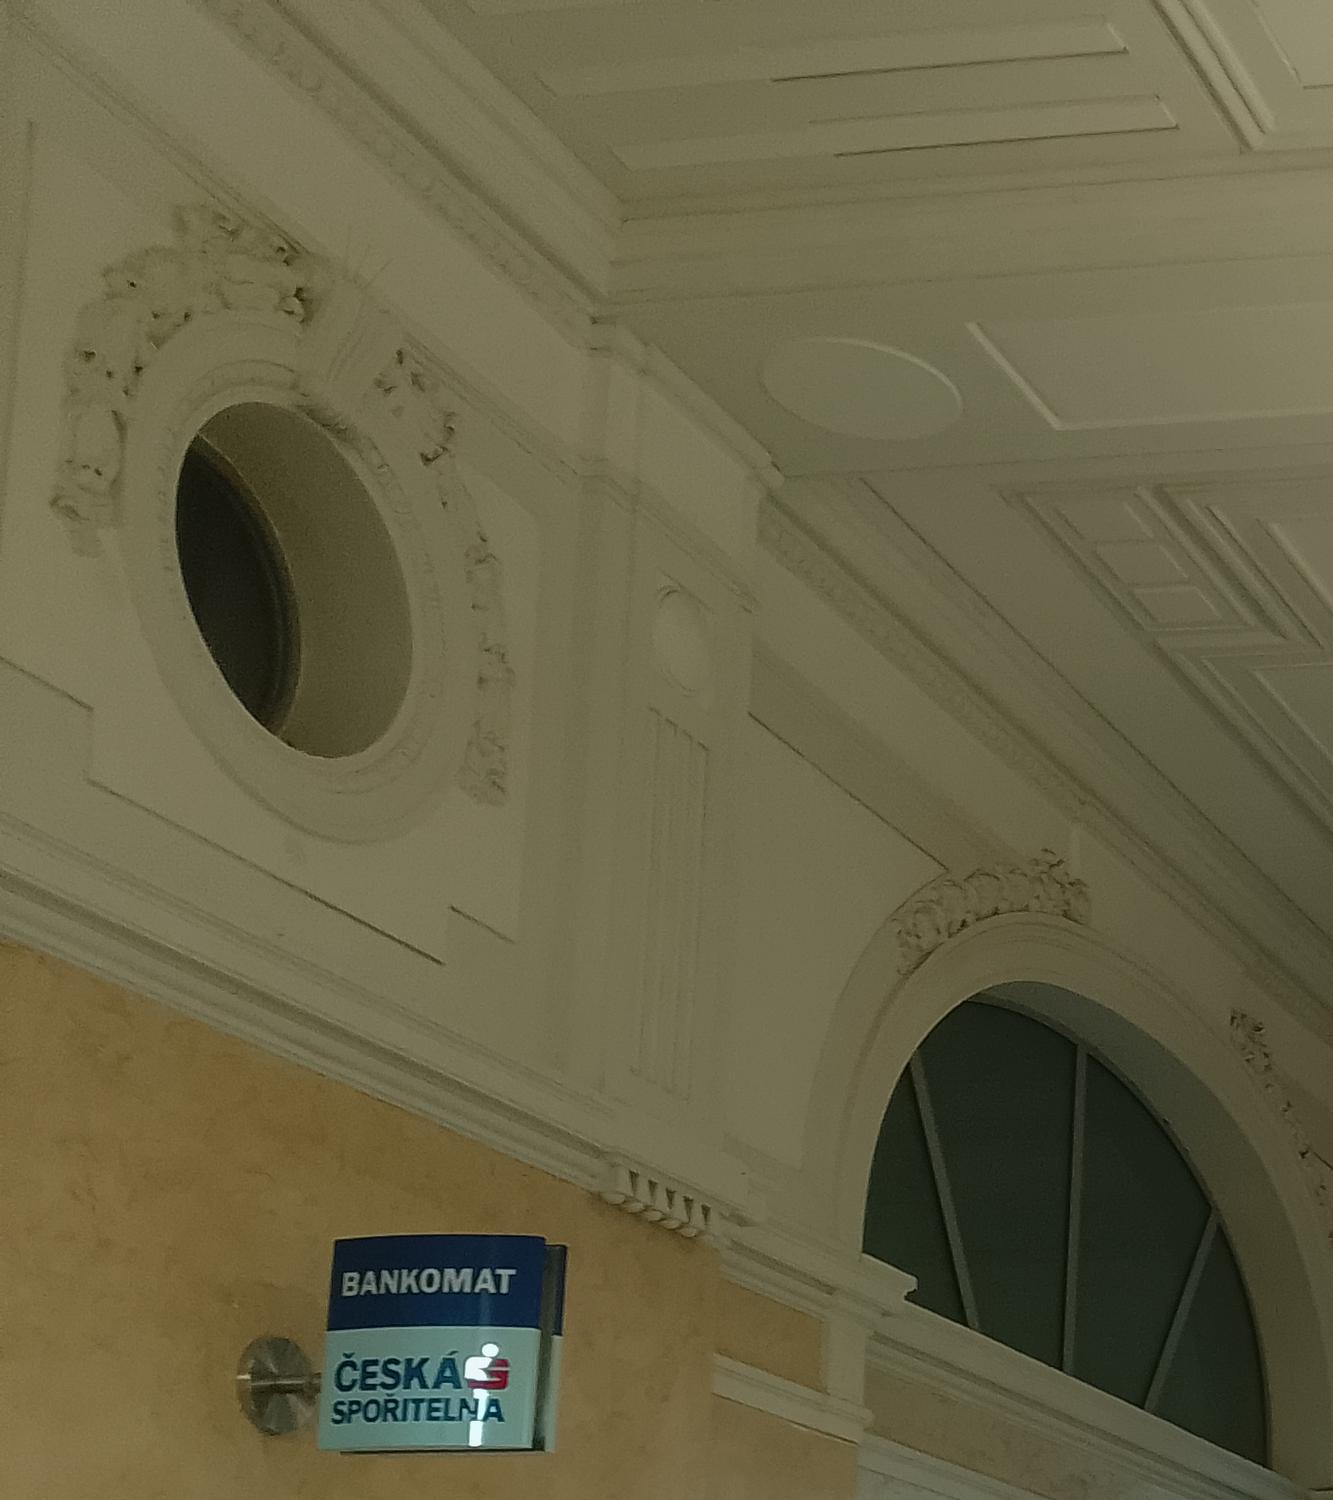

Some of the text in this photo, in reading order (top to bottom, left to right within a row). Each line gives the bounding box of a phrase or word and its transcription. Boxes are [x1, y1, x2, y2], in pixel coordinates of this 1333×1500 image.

[341, 1267, 518, 1298] BANKOMAT
[333, 1350, 464, 1393] ČESKÁ
[330, 1393, 506, 1426] SPOŘITELNA
